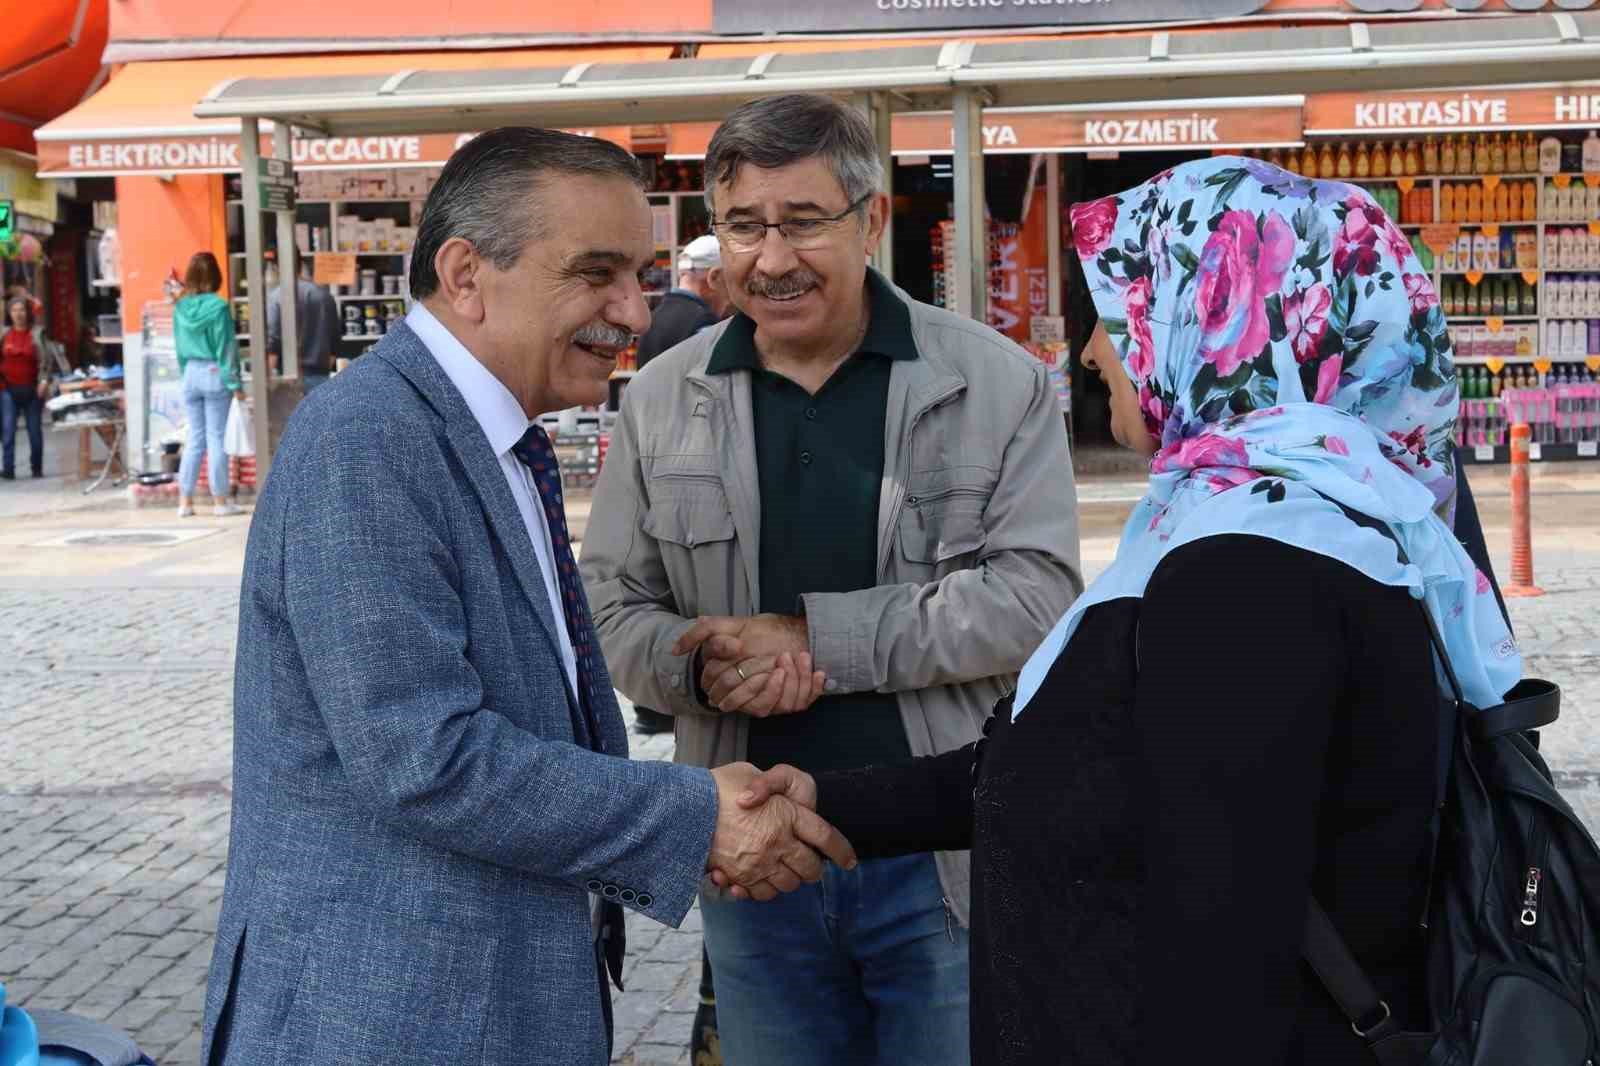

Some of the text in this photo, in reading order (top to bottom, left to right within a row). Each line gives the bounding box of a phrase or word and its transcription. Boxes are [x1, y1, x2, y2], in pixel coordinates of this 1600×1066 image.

[1354, 93, 1508, 127] KIRTASİYE
[1084, 113, 1219, 144] KOZMETİK
[68, 136, 240, 167] ELEKTRONİK
[271, 136, 420, 161] UCCACIYE
